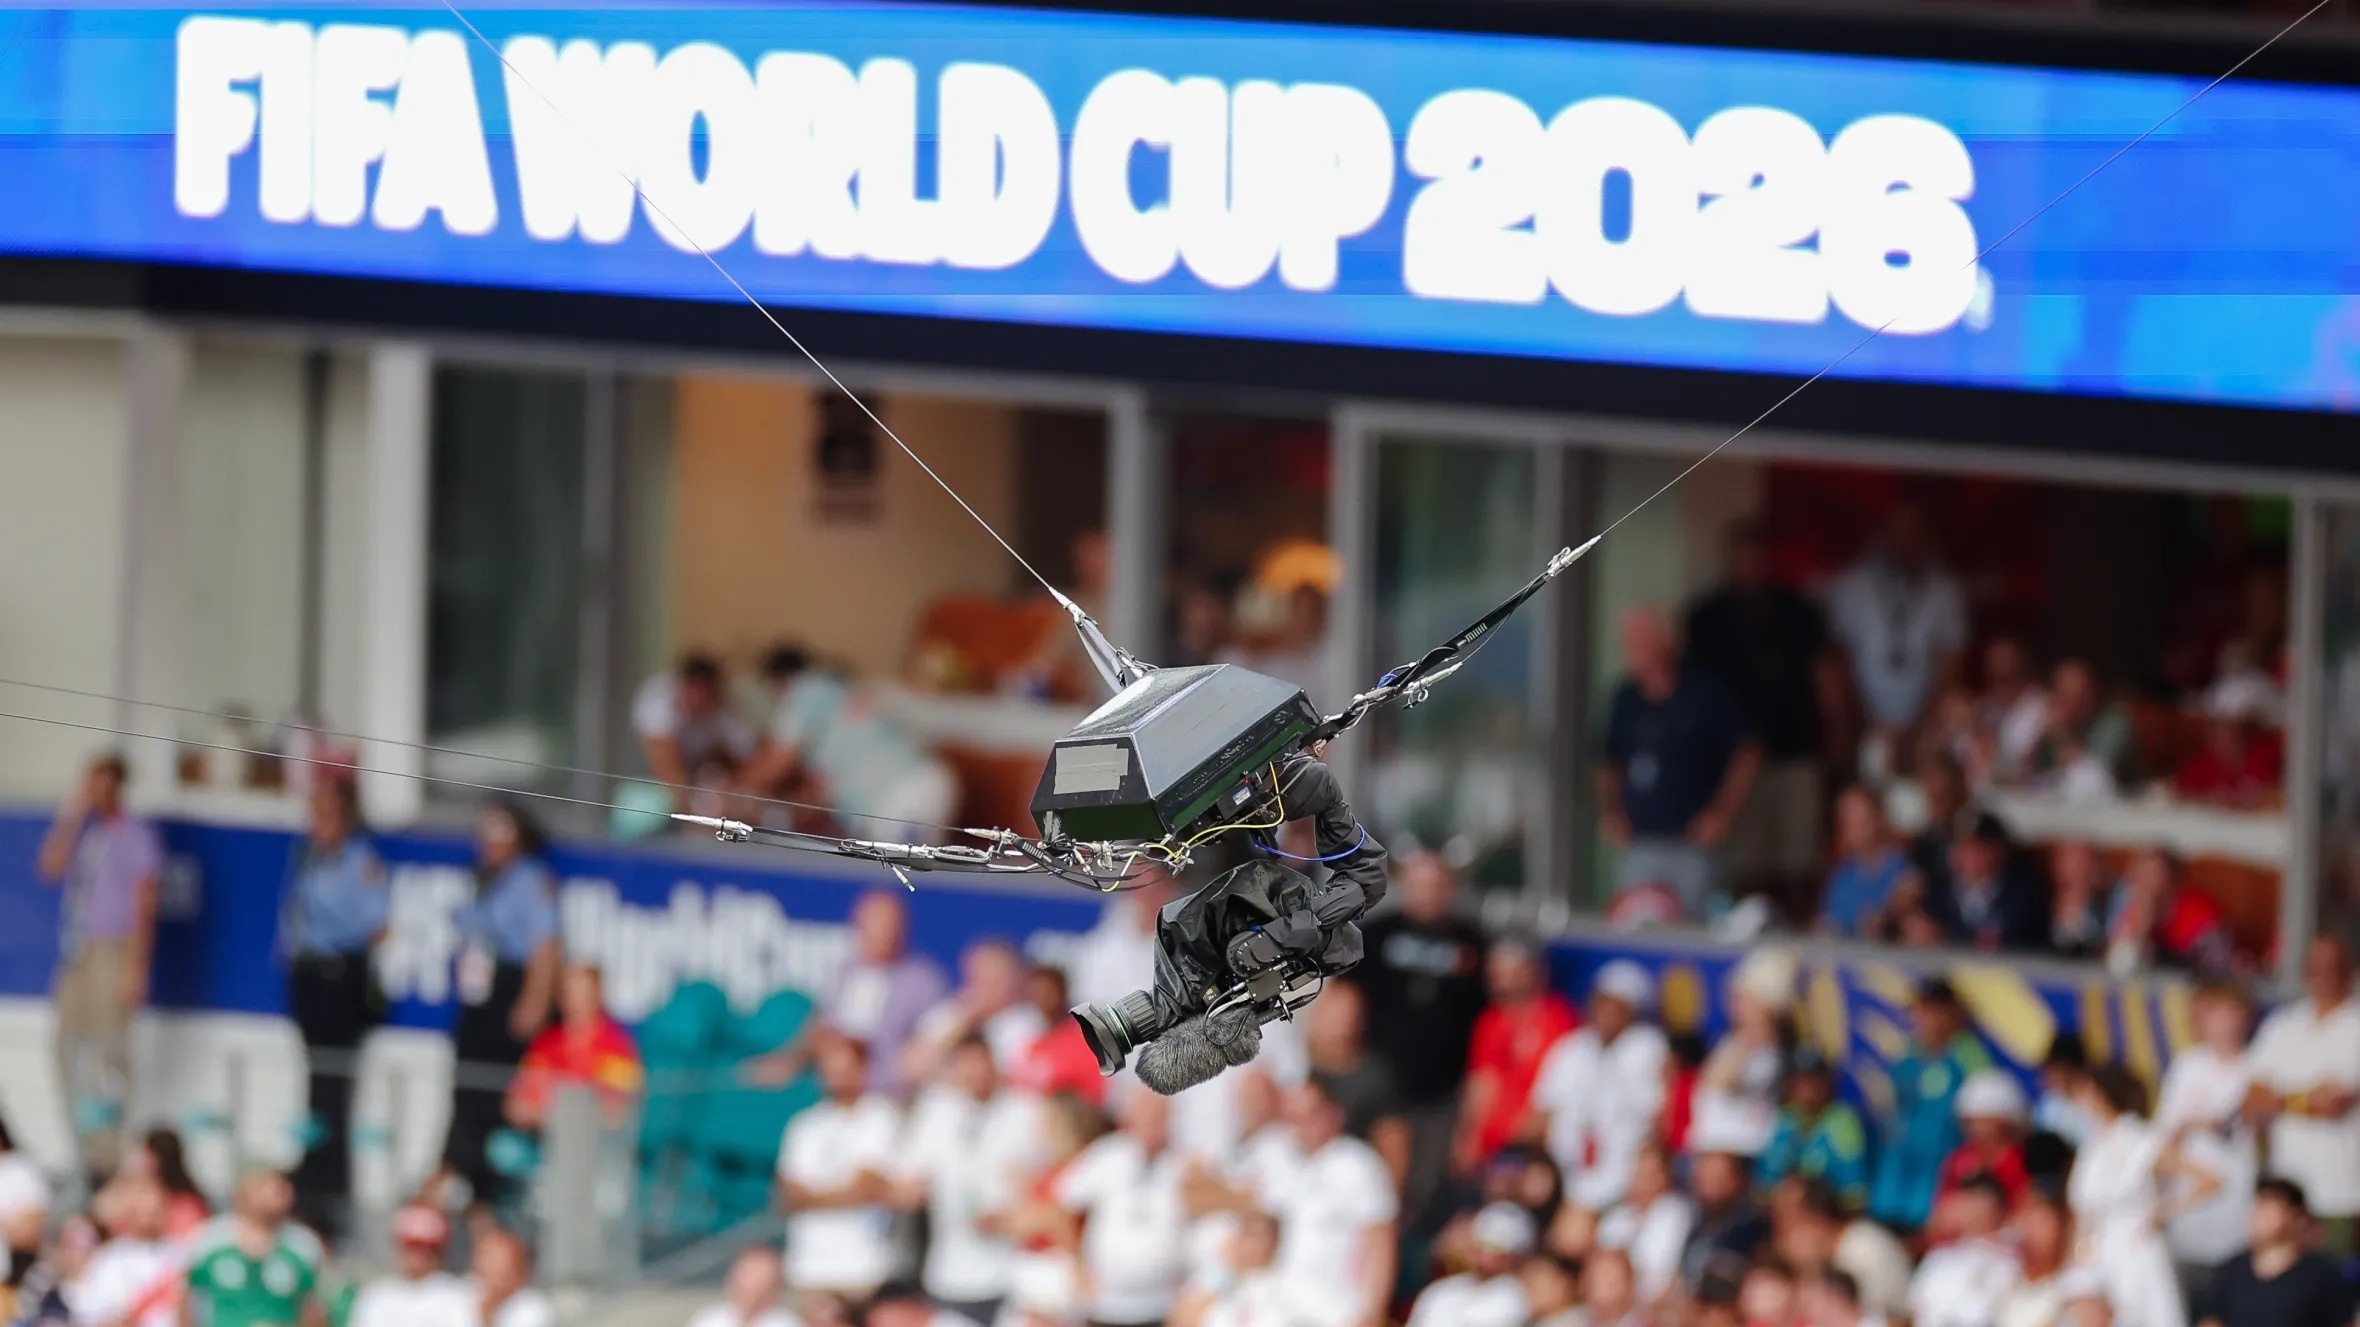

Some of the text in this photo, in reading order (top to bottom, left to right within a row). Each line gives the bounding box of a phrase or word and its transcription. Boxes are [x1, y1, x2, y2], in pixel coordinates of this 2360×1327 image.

[175, 17, 1979, 335] FIFA WORLD CUP 2026
